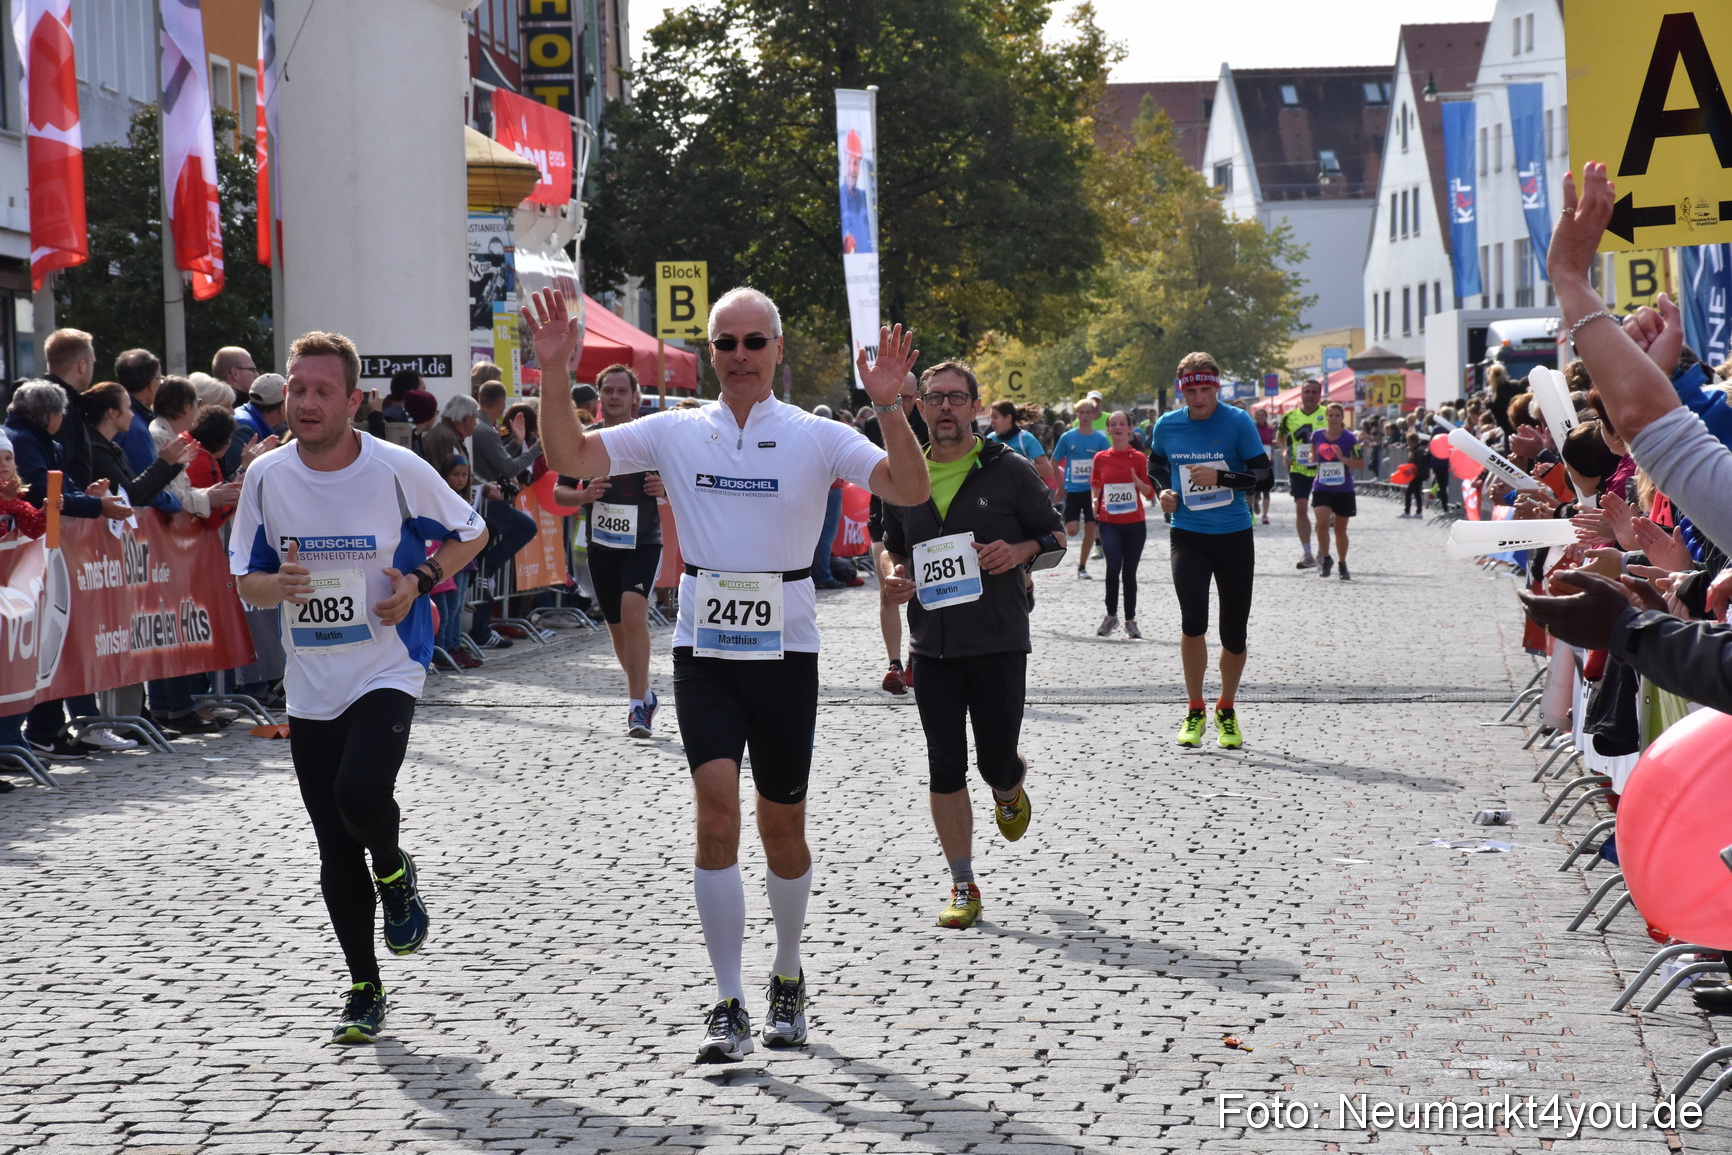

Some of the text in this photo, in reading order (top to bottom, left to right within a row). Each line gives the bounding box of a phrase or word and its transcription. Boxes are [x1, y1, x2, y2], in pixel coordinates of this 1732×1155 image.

[1617, 11, 1732, 177] A
[1519, 161, 1540, 209] K&L
[662, 264, 702, 279] Block
[1629, 258, 1659, 298] B
[670, 285, 696, 322] B
[1008, 370, 1023, 391] C
[1171, 451, 1225, 460] www.hasit.de
[1322, 468, 1341, 477] 2206
[719, 478, 776, 490] BÜSCHEL
[1108, 491, 1133, 503] 2240
[597, 514, 631, 532] 2488
[304, 537, 373, 550] BÜSCHEL
[280, 551, 378, 561] FESCHNEIDTEAM
[923, 555, 966, 583] 2581
[727, 580, 760, 589] BOCK
[935, 585, 959, 596] Martin
[296, 596, 354, 623] 2083
[707, 598, 772, 627] 2479
[180, 598, 212, 643] Hits
[314, 631, 344, 641] Martin
[718, 633, 758, 645] Matthias
